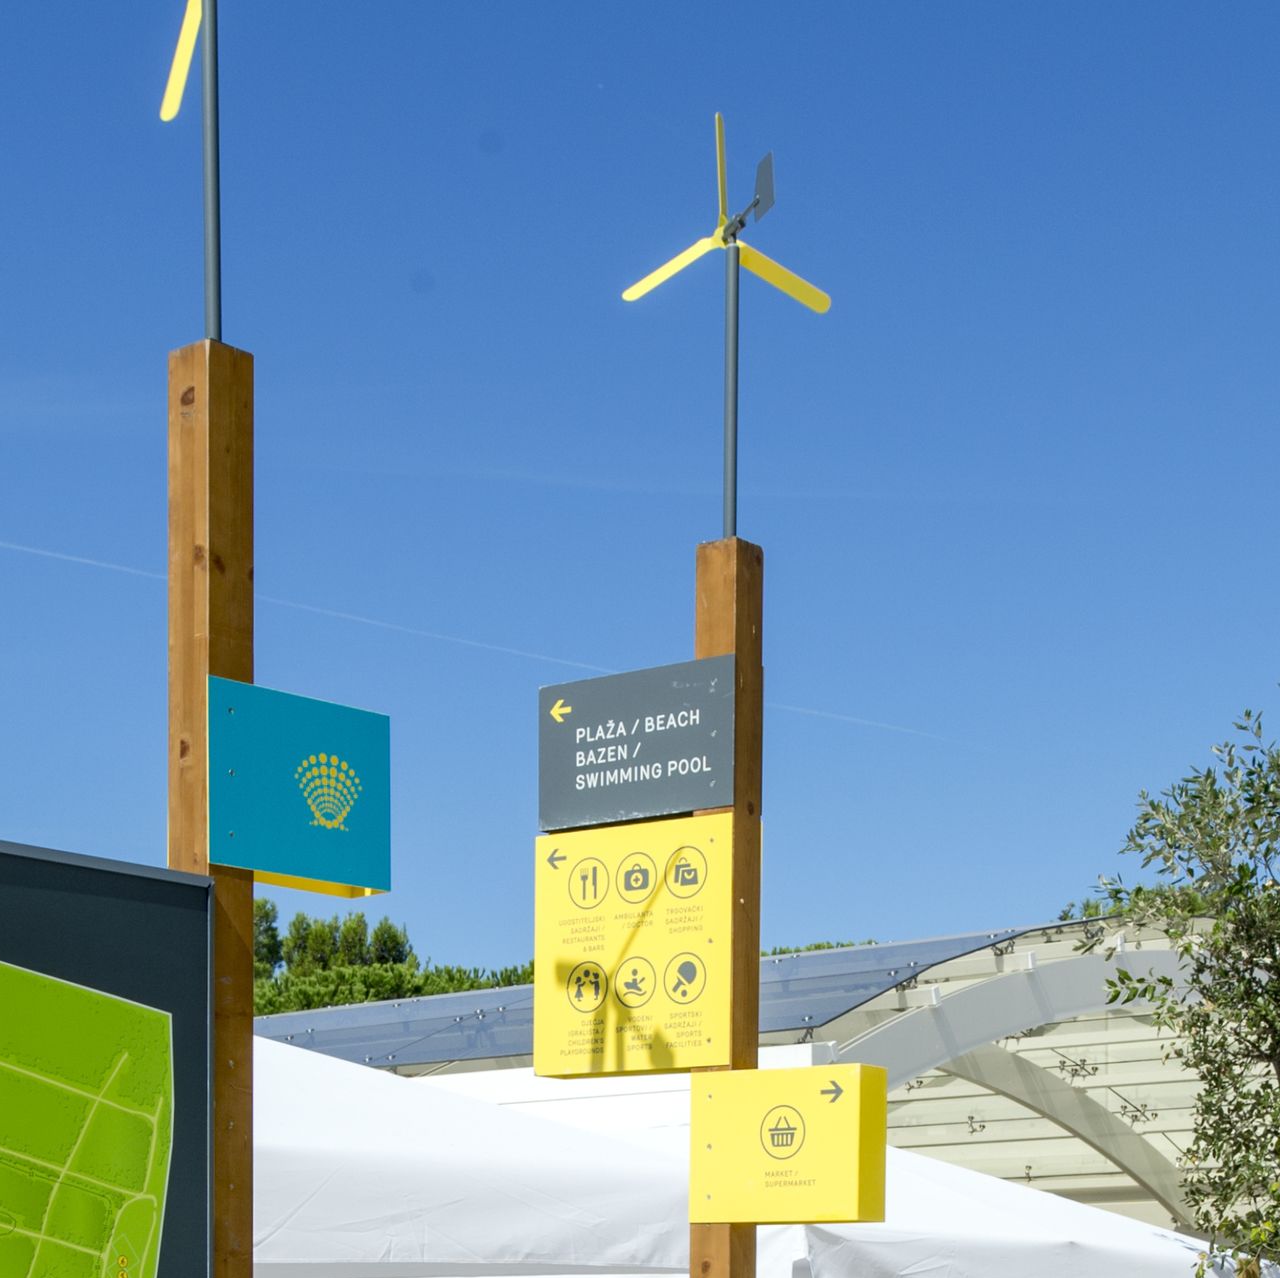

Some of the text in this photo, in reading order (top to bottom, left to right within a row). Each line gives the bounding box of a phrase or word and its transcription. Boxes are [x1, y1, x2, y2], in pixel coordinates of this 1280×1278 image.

[575, 719, 627, 744] PLAŽA
[644, 708, 701, 732] BEACH
[575, 745, 628, 768] BAZEN
[575, 756, 712, 790] SWIMMING POOL
[666, 905, 704, 914] TRGOVAČKI
[614, 911, 653, 920] AMBULANTA
[665, 915, 698, 925] SADRŽAJI
[570, 925, 601, 934] SADRŽAJI
[669, 925, 703, 934] SHOPPING
[562, 935, 605, 944] RESTAURANTS
[669, 1011, 702, 1019] SPORTSKI
[664, 1019, 697, 1029] SADRŽAJI
[616, 1024, 647, 1034] SPORTOVI
[631, 1033, 652, 1041] WATER
[676, 1030, 702, 1038] SPORTS
[627, 1043, 653, 1051] SPORTS
[665, 1040, 702, 1049] FACILITIES
[560, 1046, 605, 1056] PLAYGROUNDS
[765, 1170, 792, 1178] MARKET
[765, 1179, 816, 1188] SUPERMARKET
